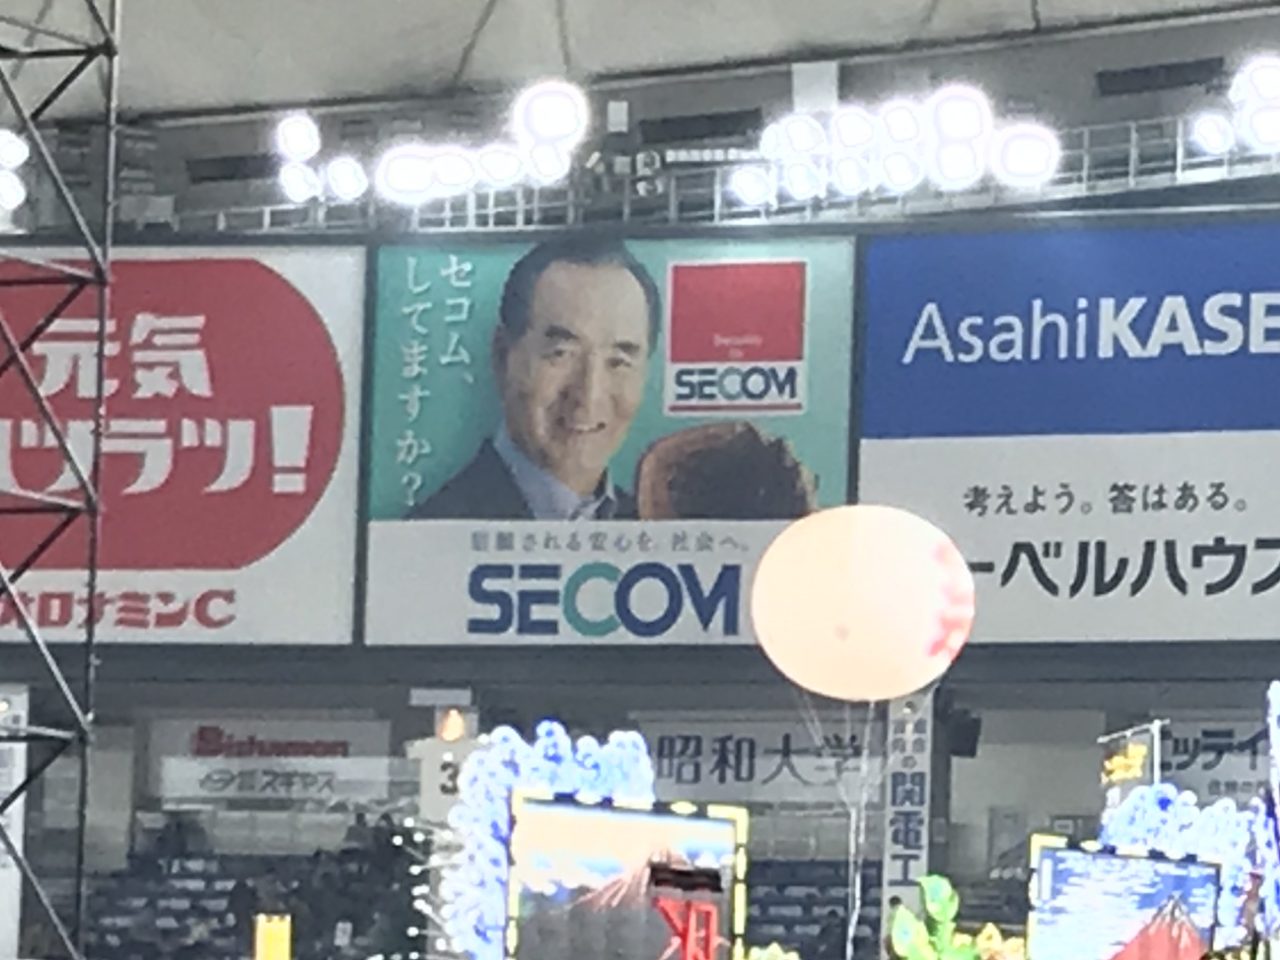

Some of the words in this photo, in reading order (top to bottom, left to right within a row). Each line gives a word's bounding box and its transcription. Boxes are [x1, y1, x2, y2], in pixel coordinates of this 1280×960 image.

[33, 312, 213, 398] 元気
[440, 254, 475, 384] セコム、
[674, 366, 798, 401] SECOM
[467, 561, 743, 638] SECOM
[656, 733, 863, 786] 昭和大学
